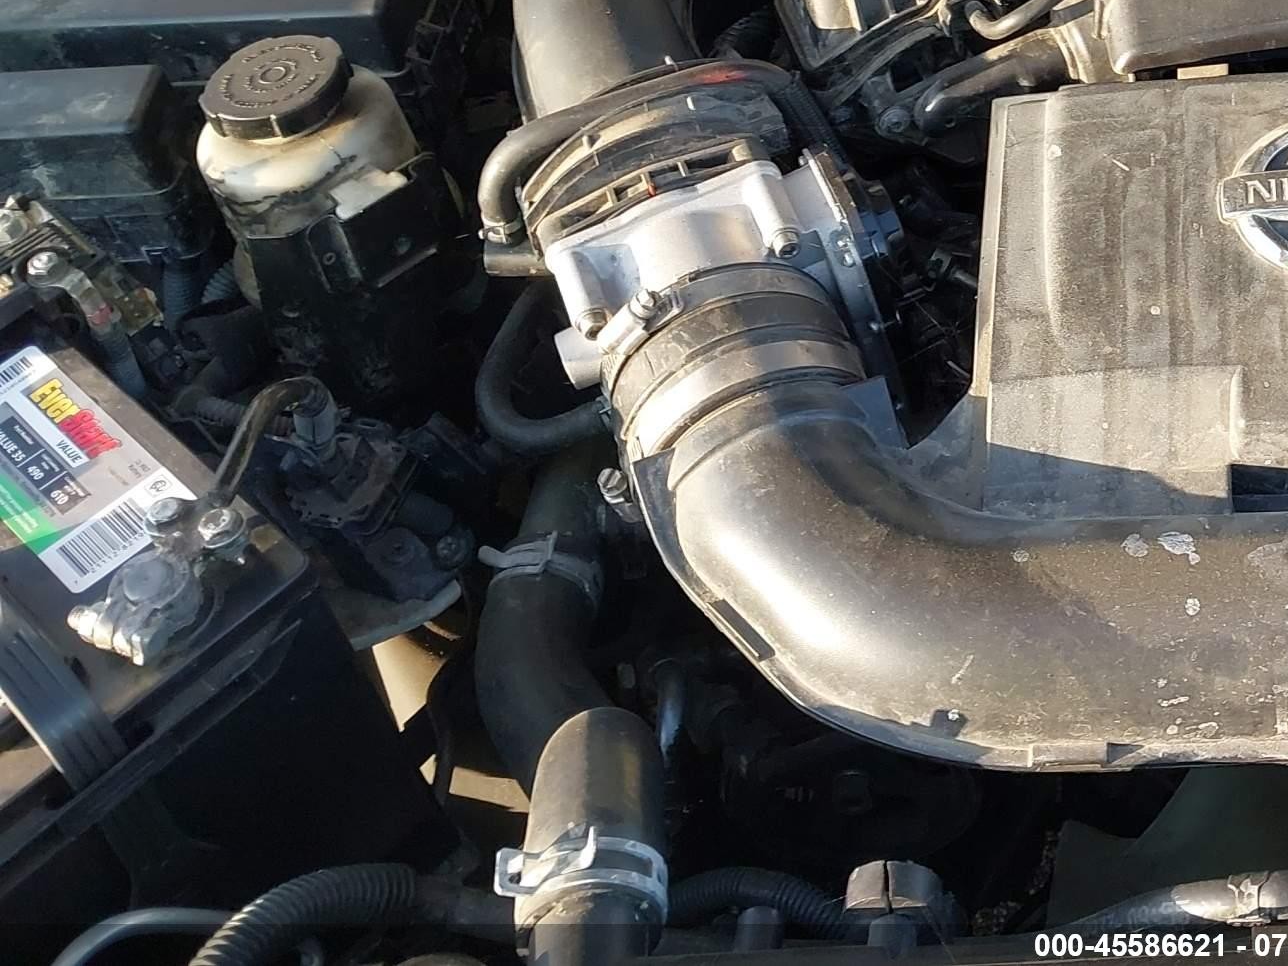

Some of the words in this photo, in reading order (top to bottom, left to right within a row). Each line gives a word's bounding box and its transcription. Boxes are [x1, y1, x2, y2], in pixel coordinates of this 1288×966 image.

[11, 450, 26, 462] 35
[56, 439, 83, 463] VALUE
[27, 466, 44, 480] 490
[50, 490, 69, 504] 610
